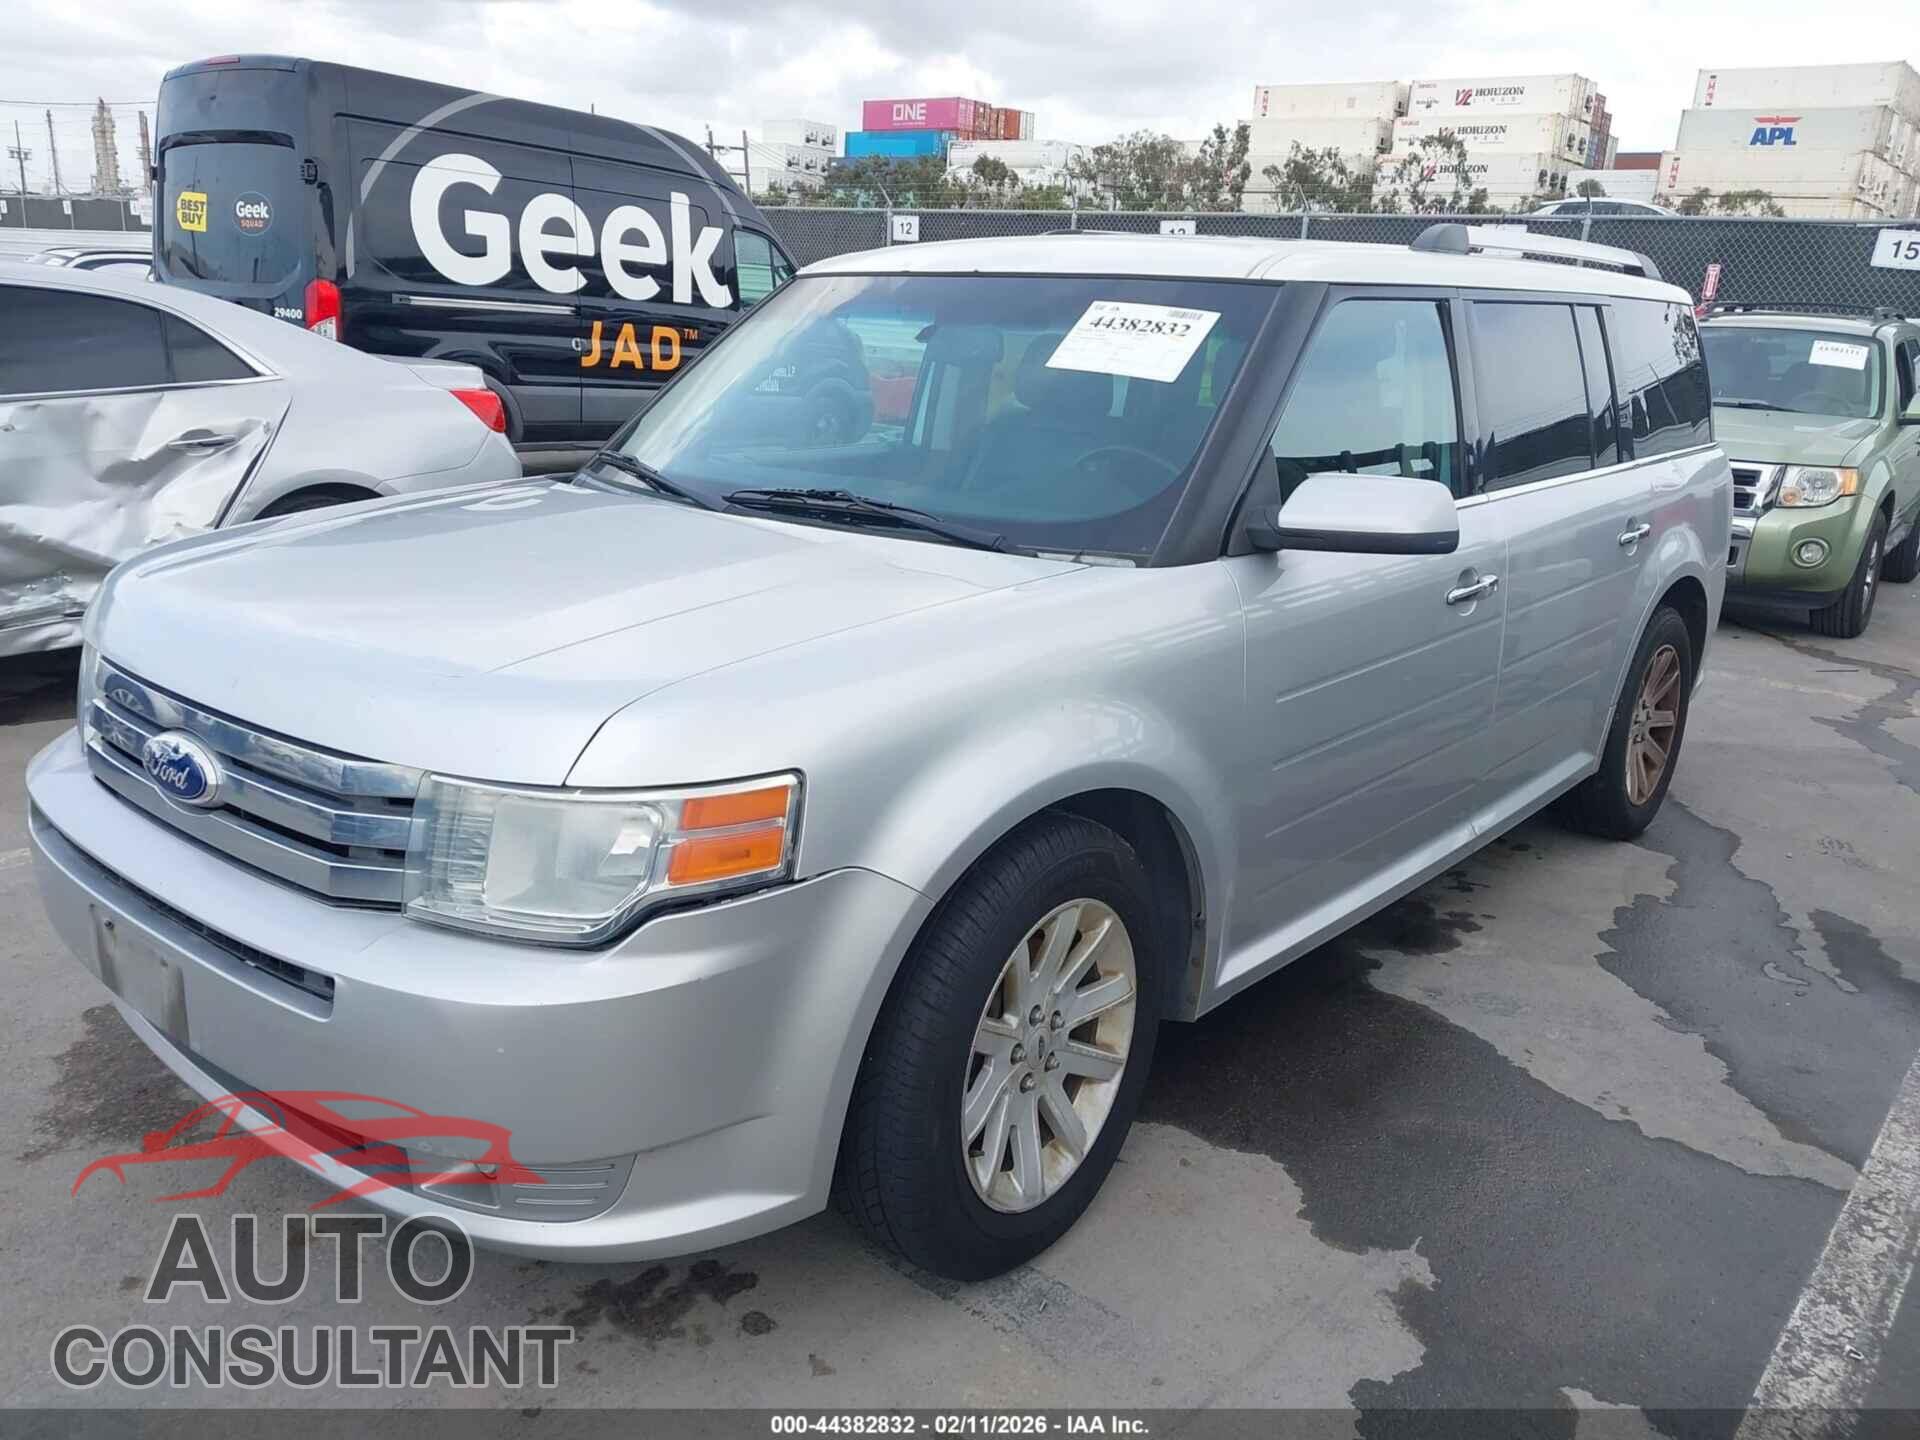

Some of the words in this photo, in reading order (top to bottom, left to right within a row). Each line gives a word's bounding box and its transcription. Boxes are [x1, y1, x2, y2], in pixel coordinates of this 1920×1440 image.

[1475, 86, 1525, 96] HORIZON
[893, 103, 927, 121] ONE
[1457, 125, 1508, 135] HORIZON
[1750, 127, 1797, 146] APL
[181, 199, 206, 213] BEST
[235, 201, 269, 219] Geek
[181, 212, 203, 225] BUY
[239, 219, 264, 228] SQUAD
[410, 153, 734, 308] Geek
[900, 222, 913, 235] 12
[1892, 240, 1920, 260] 15
[273, 306, 303, 320] 29400
[1089, 315, 1192, 337] 44382832
[151, 742, 190, 790] Ford
